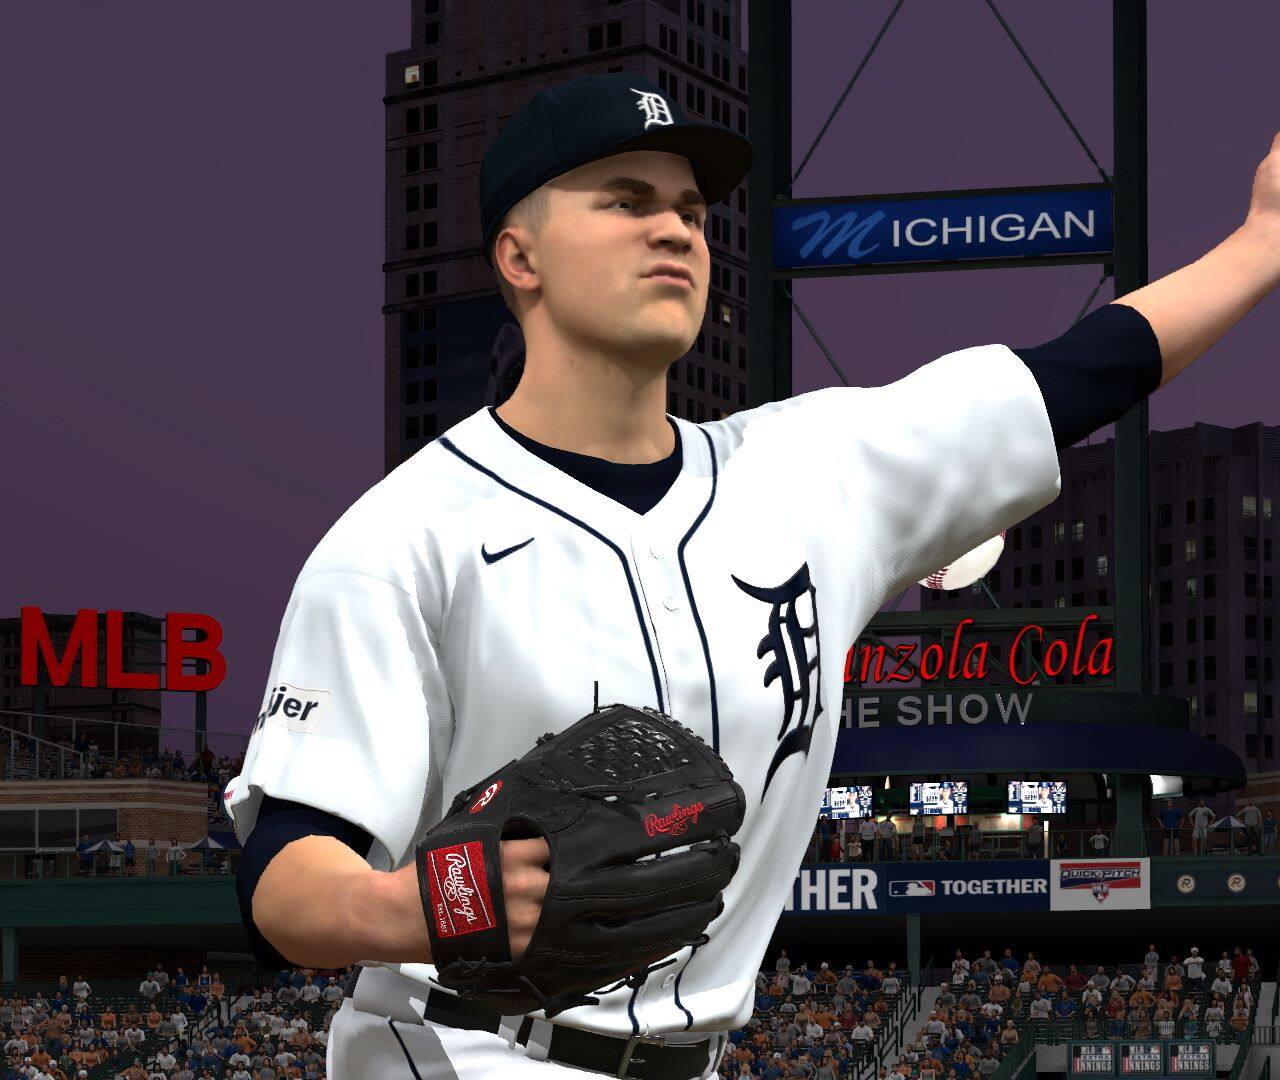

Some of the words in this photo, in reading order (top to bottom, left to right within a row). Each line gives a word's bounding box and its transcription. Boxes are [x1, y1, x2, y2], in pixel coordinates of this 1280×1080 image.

[791, 209, 1097, 260] MICHIGAN
[21, 606, 227, 692] MLB
[1009, 614, 1115, 685] Cola
[896, 692, 1034, 728] SHOW
[446, 853, 477, 925] Rawlings
[941, 879, 1048, 896] TOGETHER
